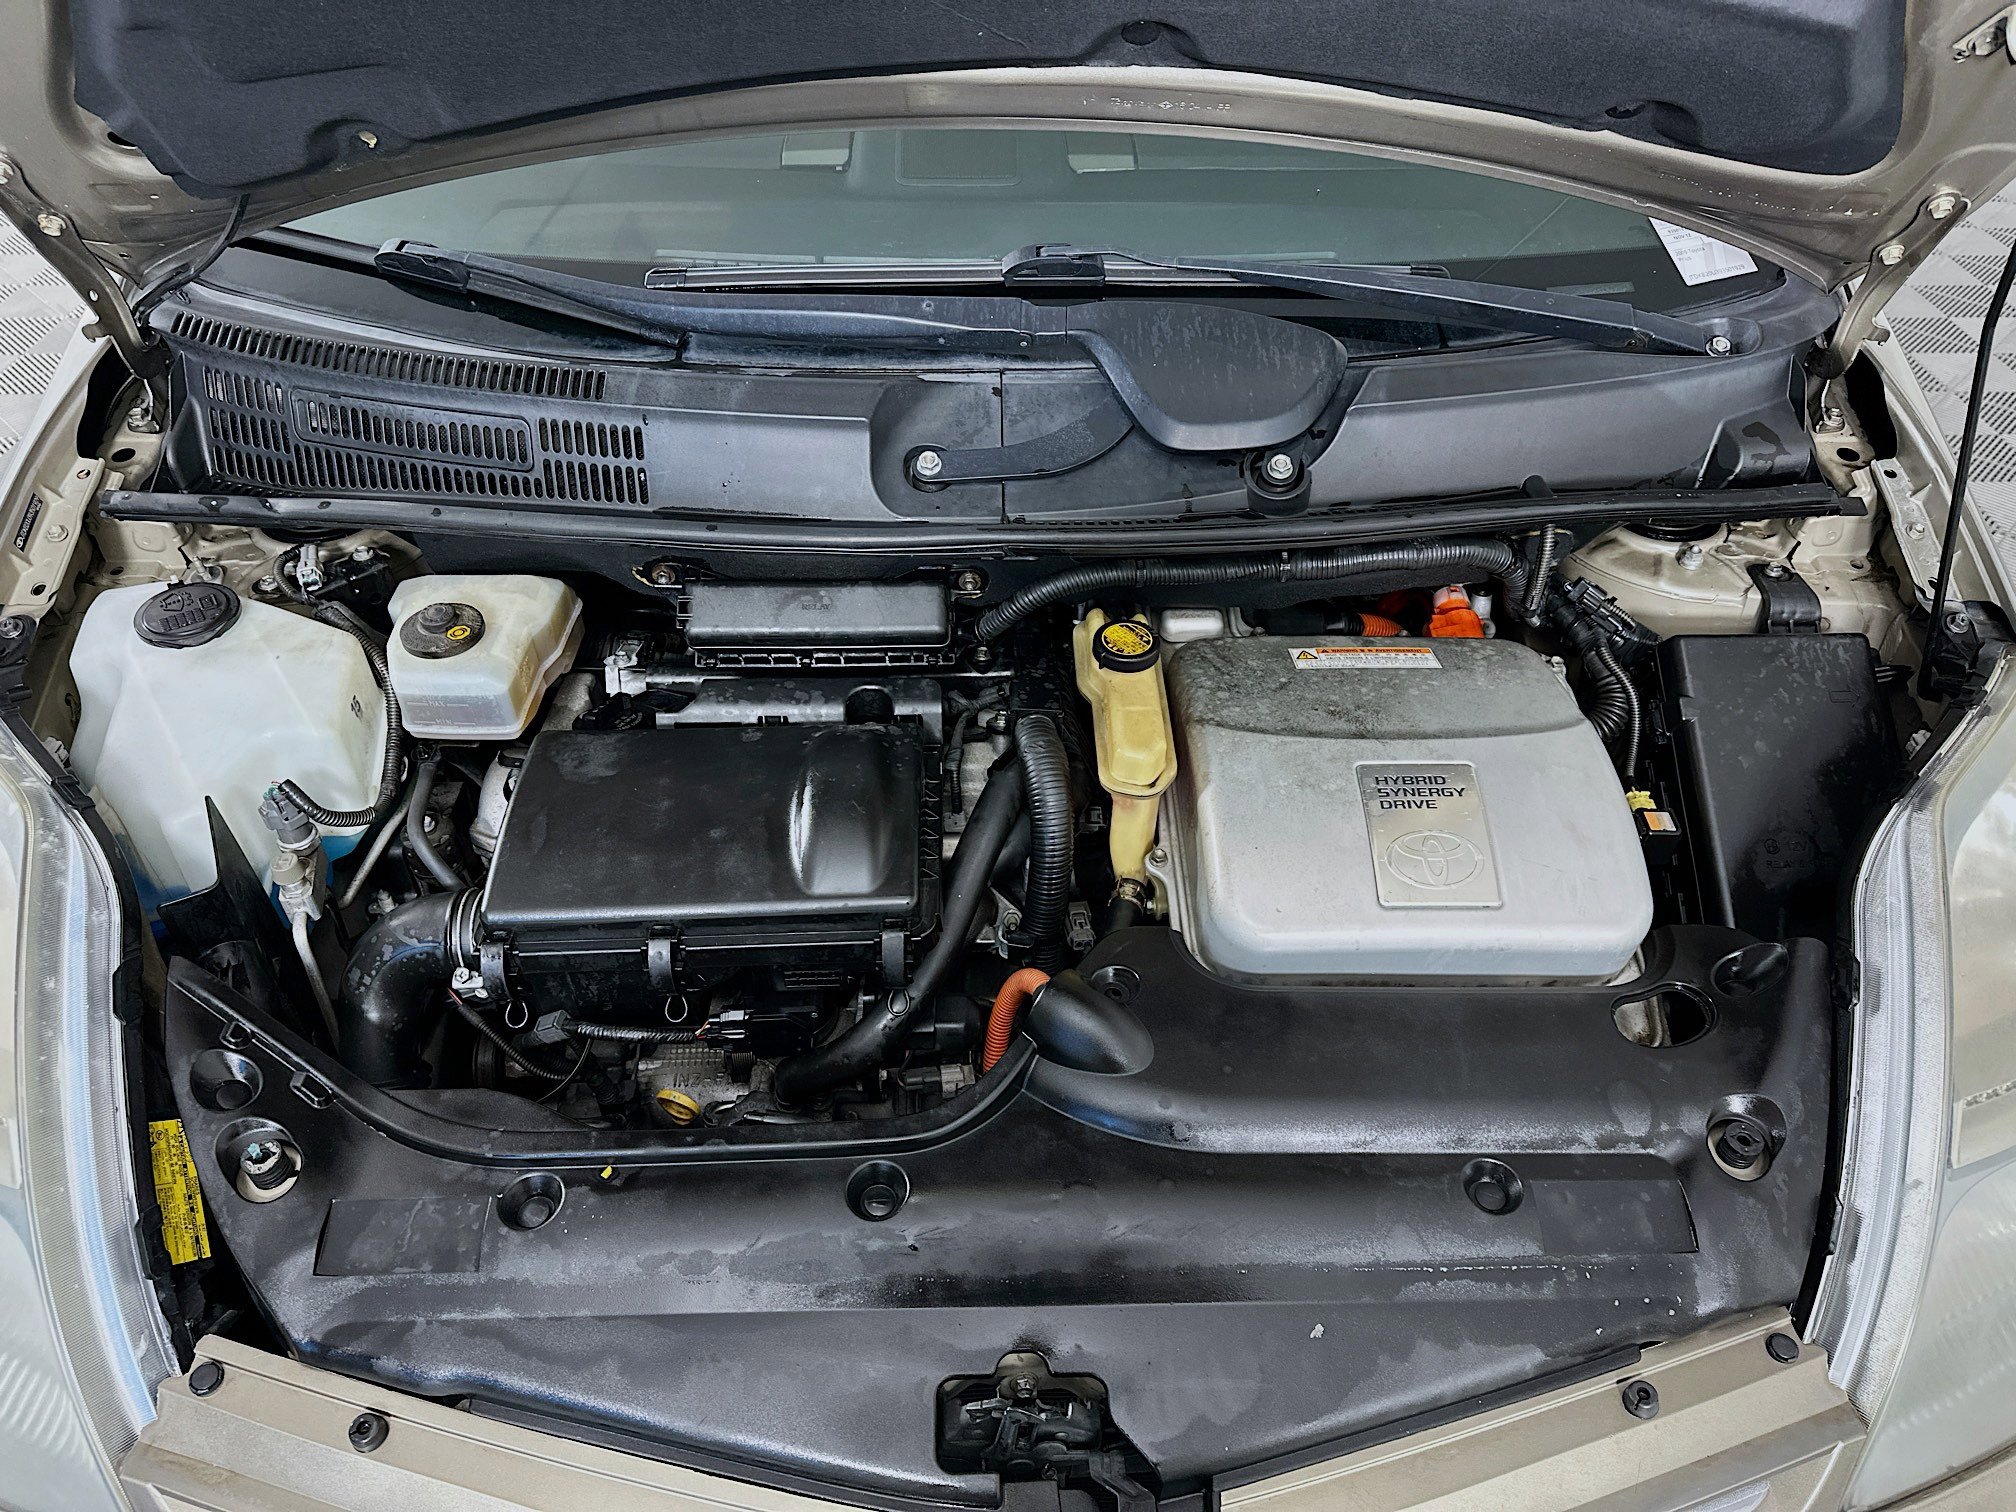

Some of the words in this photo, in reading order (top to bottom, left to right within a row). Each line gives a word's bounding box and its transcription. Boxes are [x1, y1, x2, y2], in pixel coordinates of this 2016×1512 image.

[1375, 775, 1446, 785] HYBRID
[1377, 787, 1465, 797] SYNERGY
[1380, 799, 1438, 809] DRIVE
